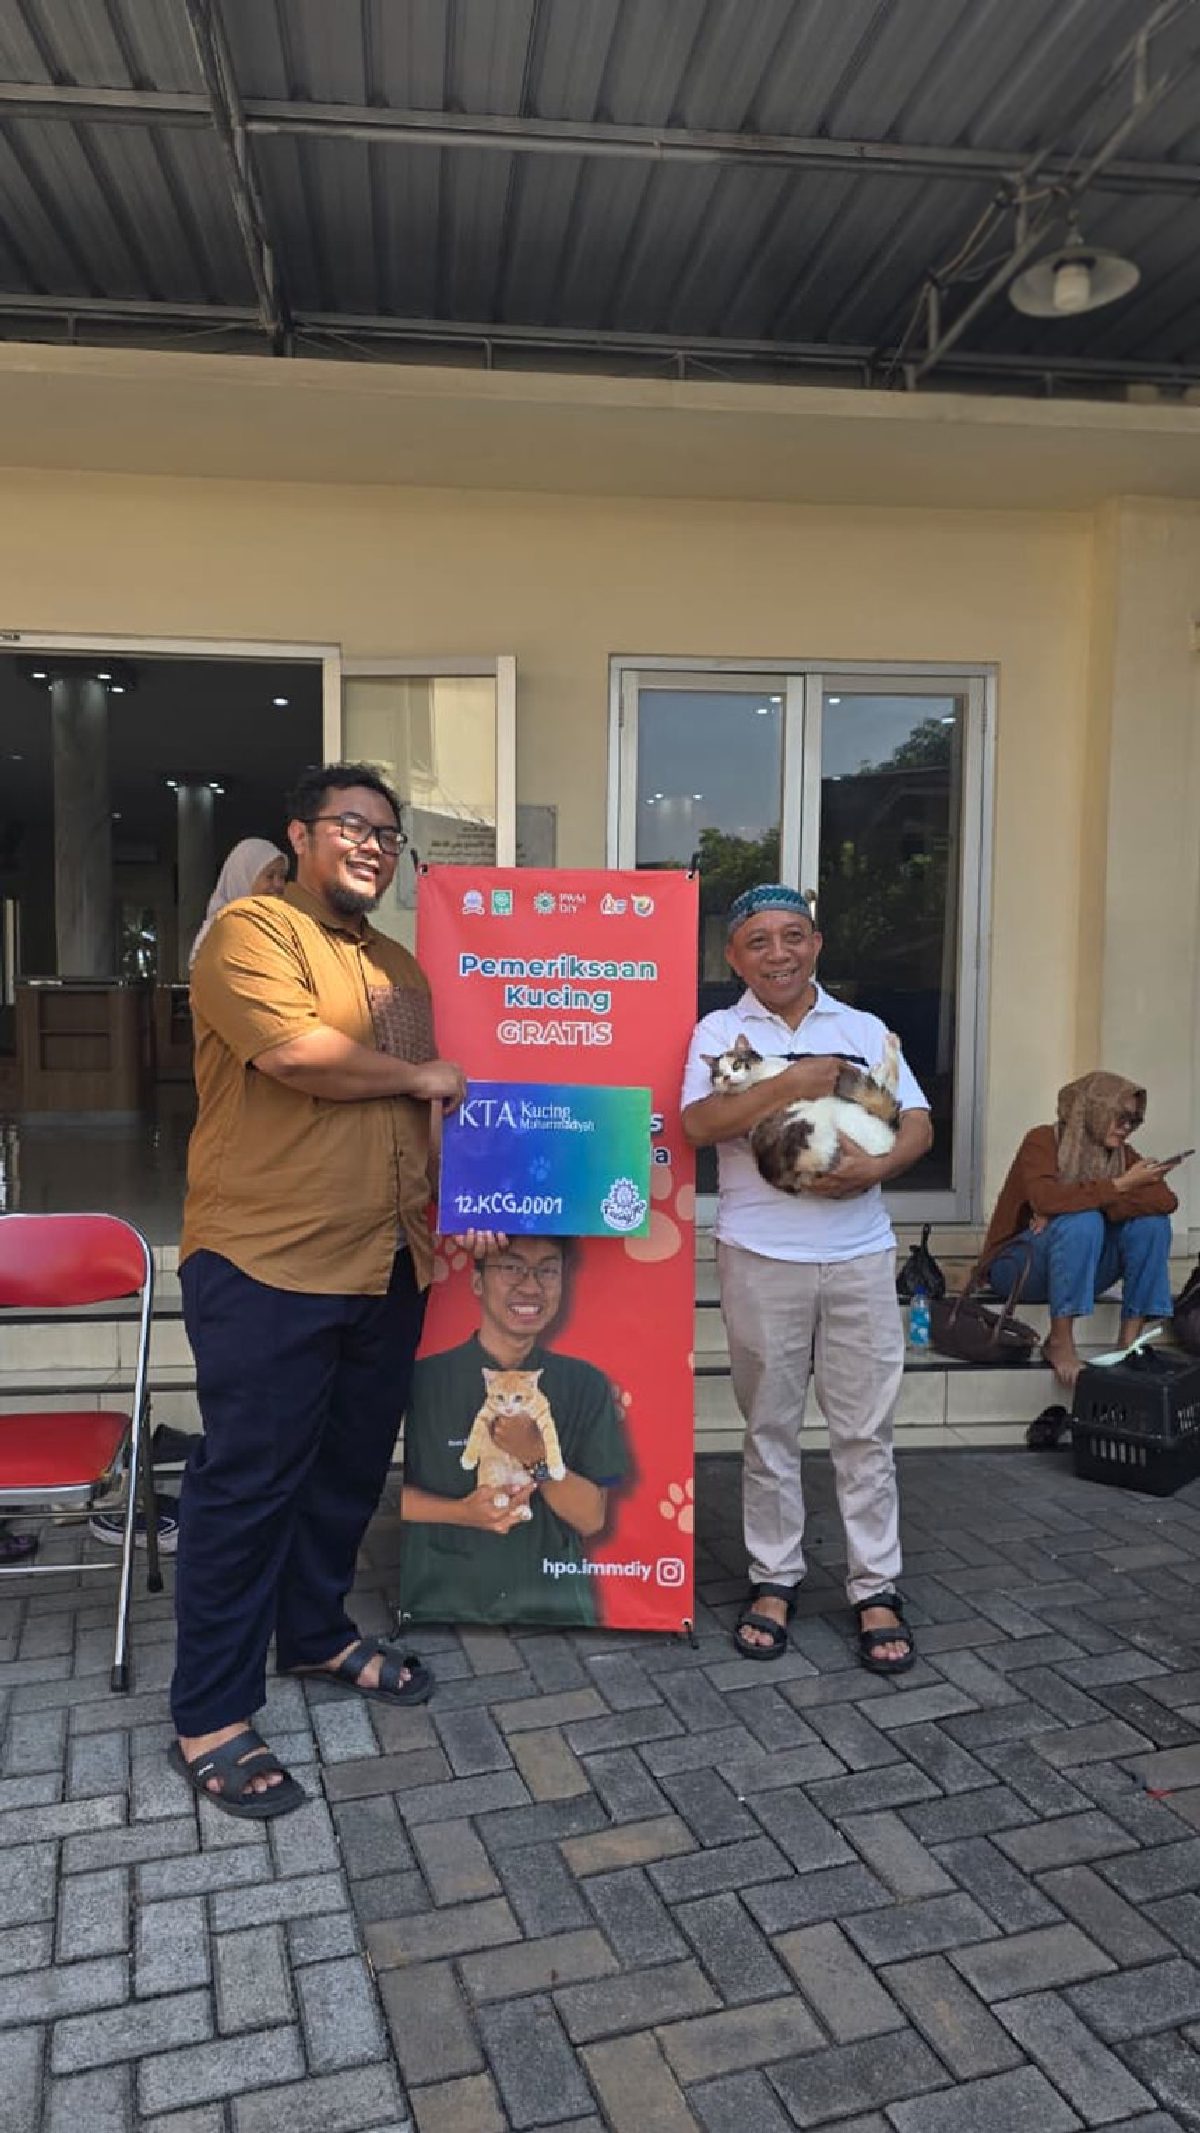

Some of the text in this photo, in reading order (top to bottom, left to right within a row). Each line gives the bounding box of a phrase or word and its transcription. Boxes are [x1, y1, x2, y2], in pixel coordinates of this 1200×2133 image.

[460, 953, 656, 980] Pemeriksaan
[505, 985, 611, 1012] Kucing
[498, 1020, 612, 1045] GRATIS
[459, 1100, 571, 1128] KTA Kucing
[455, 1193, 563, 1215] 12.KCG.0001
[543, 1558, 651, 1580] hpo.immdiy
